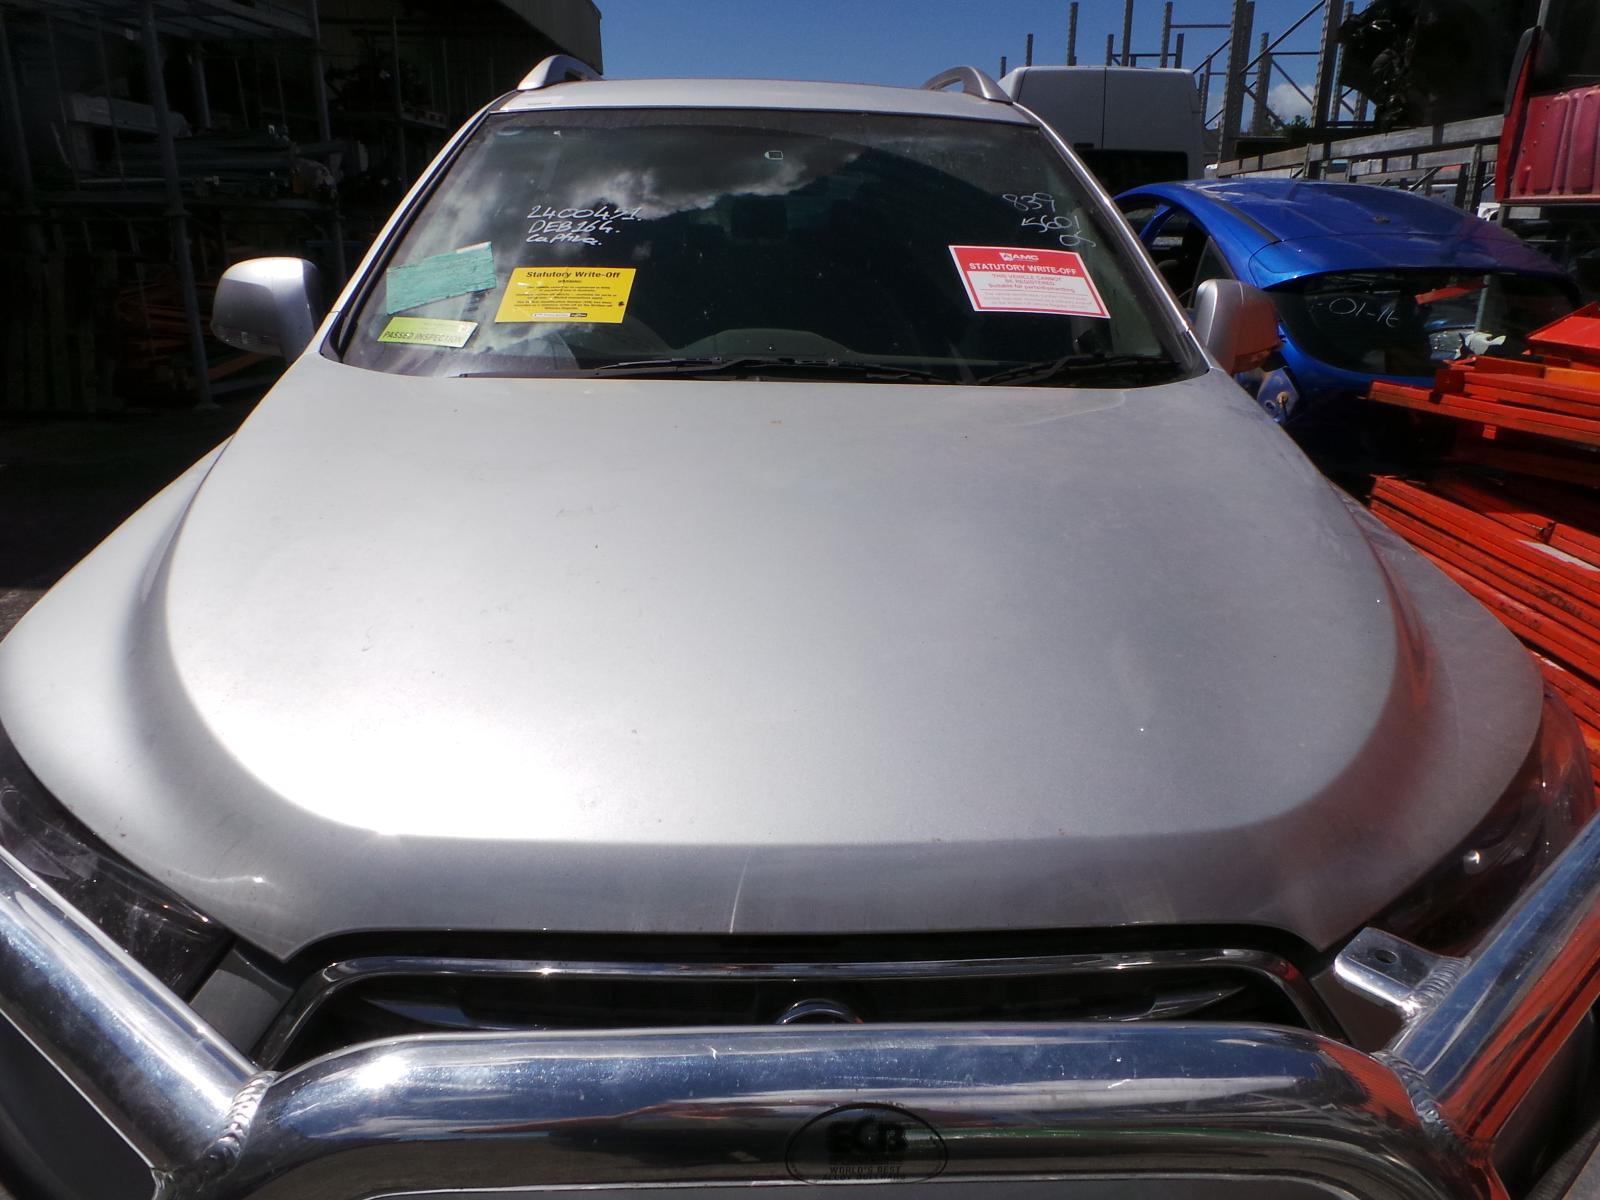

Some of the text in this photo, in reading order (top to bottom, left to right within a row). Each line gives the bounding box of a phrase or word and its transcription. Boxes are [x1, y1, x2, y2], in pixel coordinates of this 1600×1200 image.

[969, 262, 1077, 275] STATUTORY WRITE-OFF
[526, 271, 621, 279] Statutory Write-Off
[383, 330, 414, 340] PASSED
